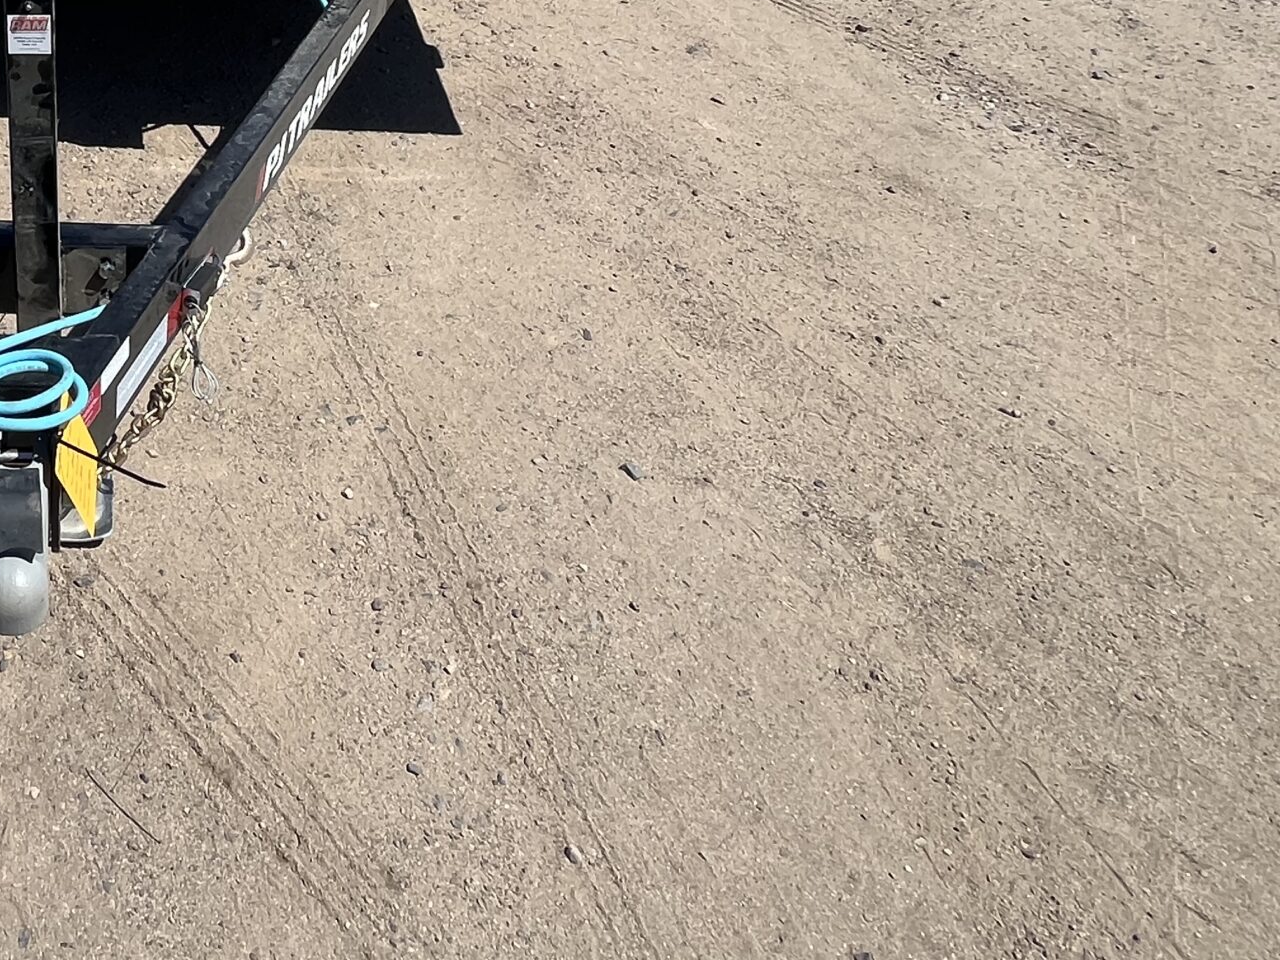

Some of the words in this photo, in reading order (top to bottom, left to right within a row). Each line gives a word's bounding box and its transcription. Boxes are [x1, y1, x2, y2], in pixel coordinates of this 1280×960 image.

[10, 20, 48, 31] RAM
[262, 131, 289, 192] PJ
[286, 8, 371, 154] TRAILERS
